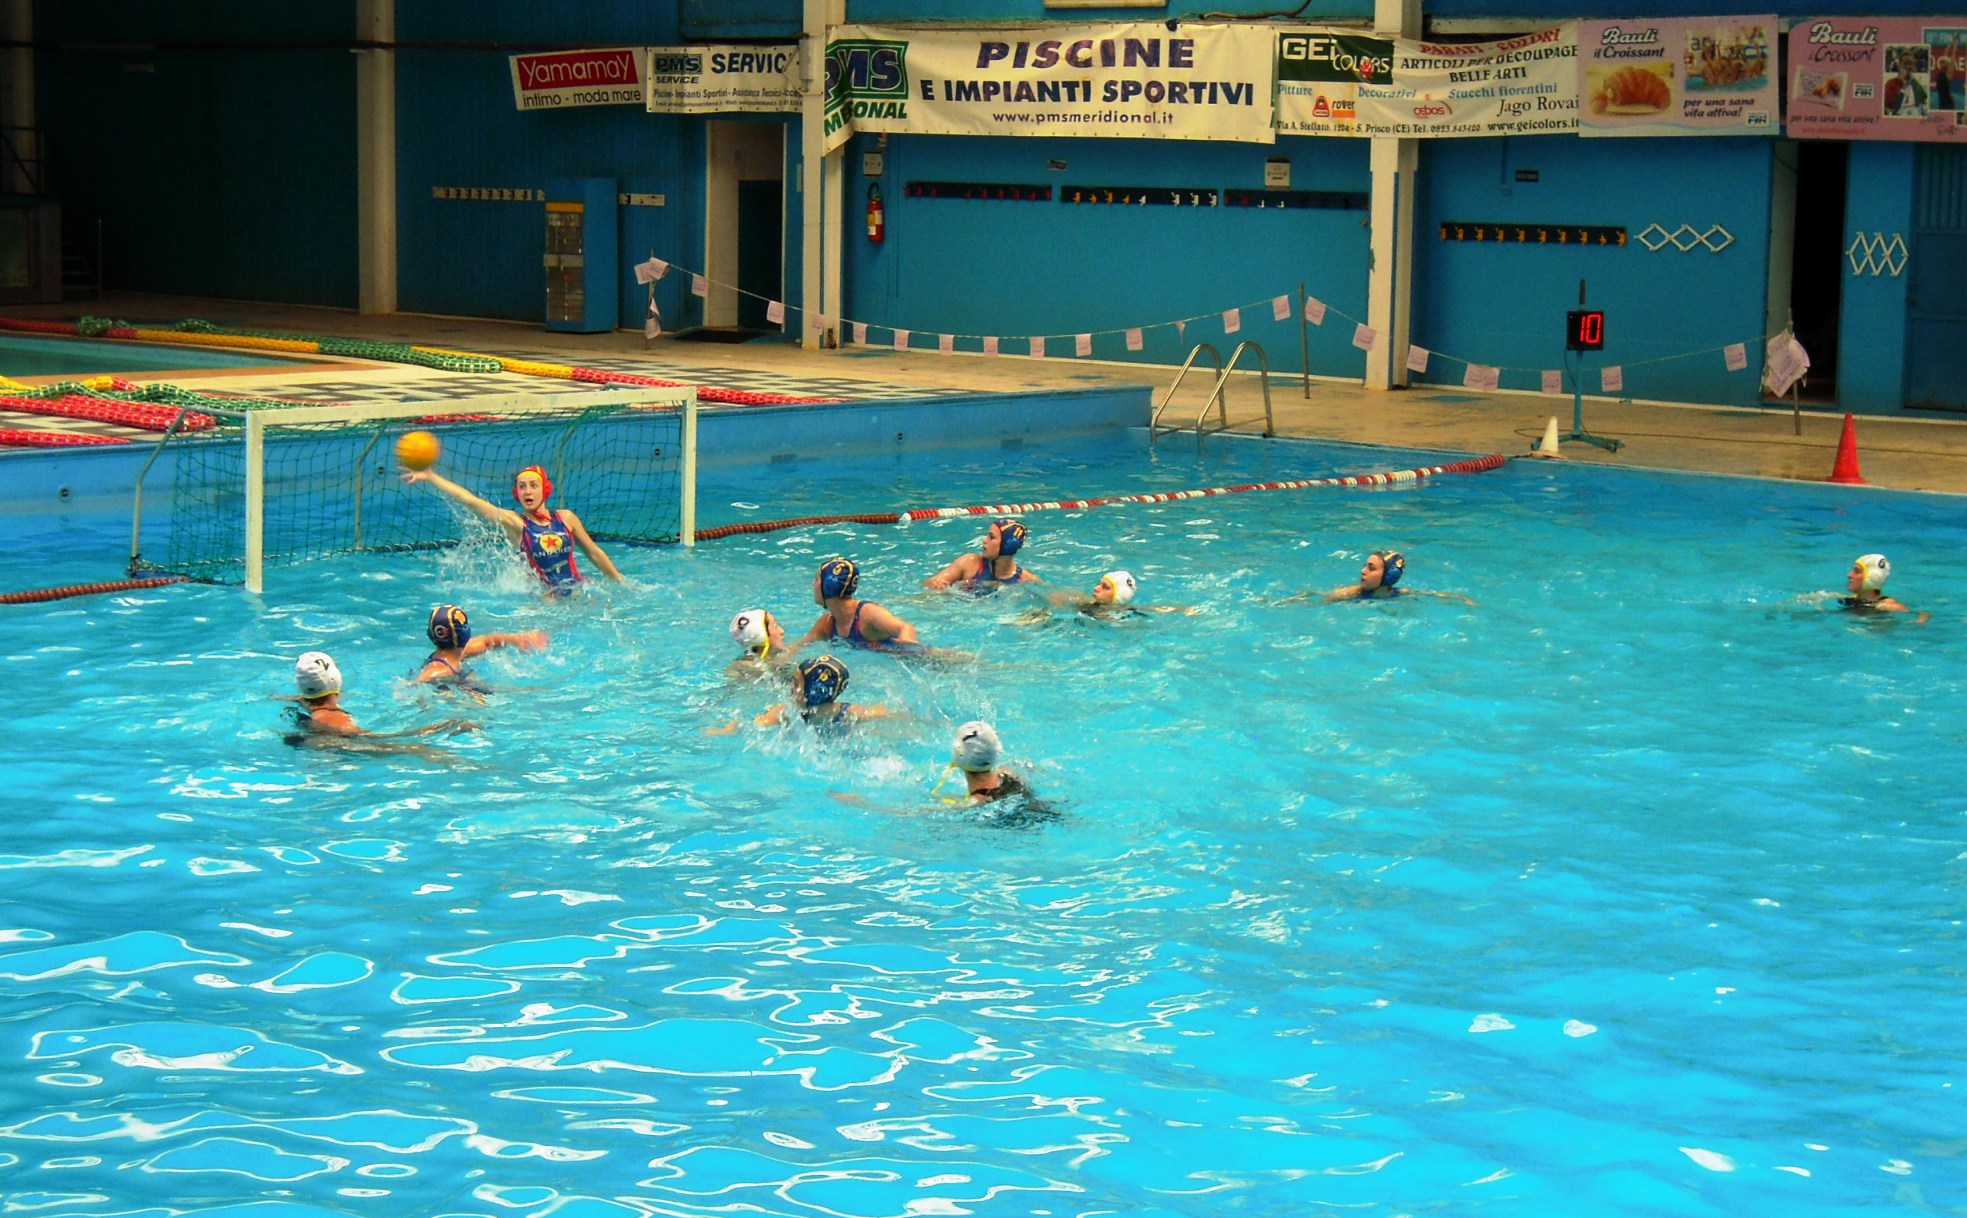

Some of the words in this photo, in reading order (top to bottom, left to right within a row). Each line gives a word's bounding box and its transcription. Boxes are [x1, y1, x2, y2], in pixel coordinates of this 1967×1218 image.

[1602, 26, 1658, 45] Bauli
[1809, 21, 1878, 45] Bauli
[976, 38, 1195, 69] PISCINE
[1401, 58, 1465, 69] ARTICOLI
[1467, 56, 1493, 67] PER
[1496, 45, 1579, 64] DECOUPAGE
[1419, 44, 1484, 56] PARATI
[1603, 45, 1665, 59] Croissant
[656, 57, 701, 72] PMS
[656, 75, 699, 84] SERVICE
[1449, 69, 1490, 82] BELLE
[1492, 66, 1527, 80] ARTI
[523, 93, 562, 108] intimo
[573, 89, 610, 103] moda
[612, 89, 641, 102] mare
[920, 80, 935, 101] E
[944, 79, 1091, 103] IMPIANTI
[1102, 80, 1254, 106] SPORTIVI
[1277, 83, 1312, 96] Pitture
[1358, 86, 1416, 99] Decorativi
[1448, 87, 1495, 99] Stucchi
[1500, 82, 1558, 97] fiorentini
[1332, 99, 1356, 110] rover
[1497, 98, 1531, 117] Jago
[1684, 99, 1702, 108] per
[1705, 99, 1726, 107] una
[1729, 98, 1755, 107] sana
[993, 110, 1174, 126] www.pmsmeridional.it
[1684, 108, 1703, 118] vita
[1706, 106, 1742, 118] attiva!
[1277, 120, 1289, 130] Via
[1365, 123, 1391, 133] Prisco
[1392, 123, 1411, 134] (CE)
[1488, 117, 1579, 132] www.geicolors.it
[1580, 314, 1602, 344] 10
